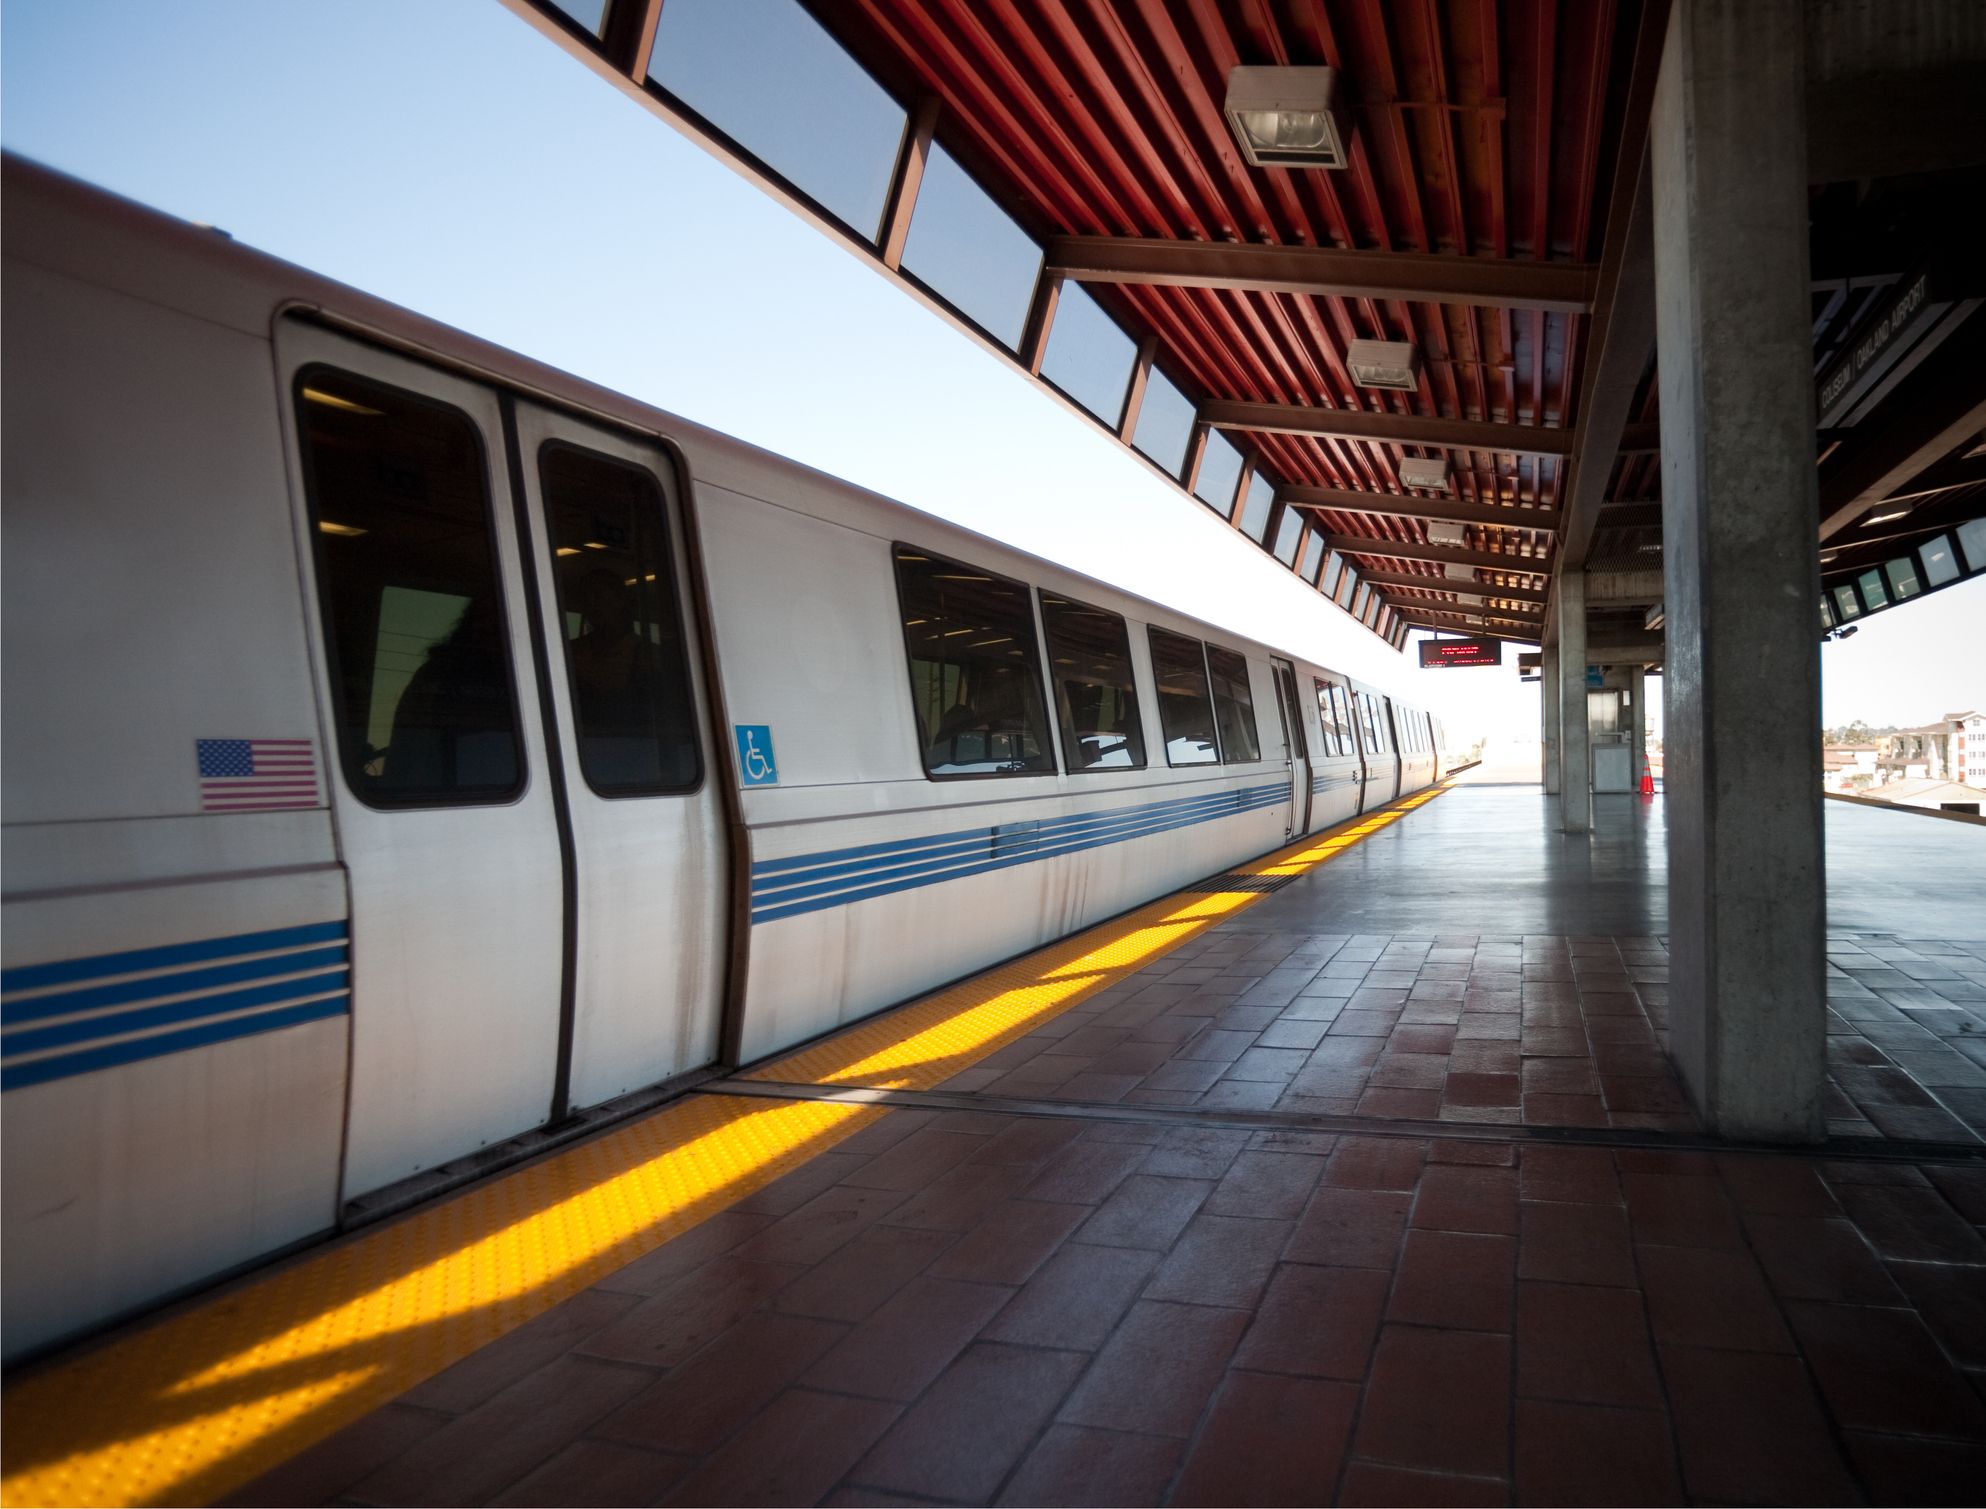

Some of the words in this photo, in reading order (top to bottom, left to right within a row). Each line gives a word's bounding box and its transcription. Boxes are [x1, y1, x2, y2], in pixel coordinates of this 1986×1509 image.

[1822, 362, 1851, 409] COLISEUM
[1857, 318, 1890, 370] OAKLAND
[1891, 273, 1926, 333] AIRPORT
